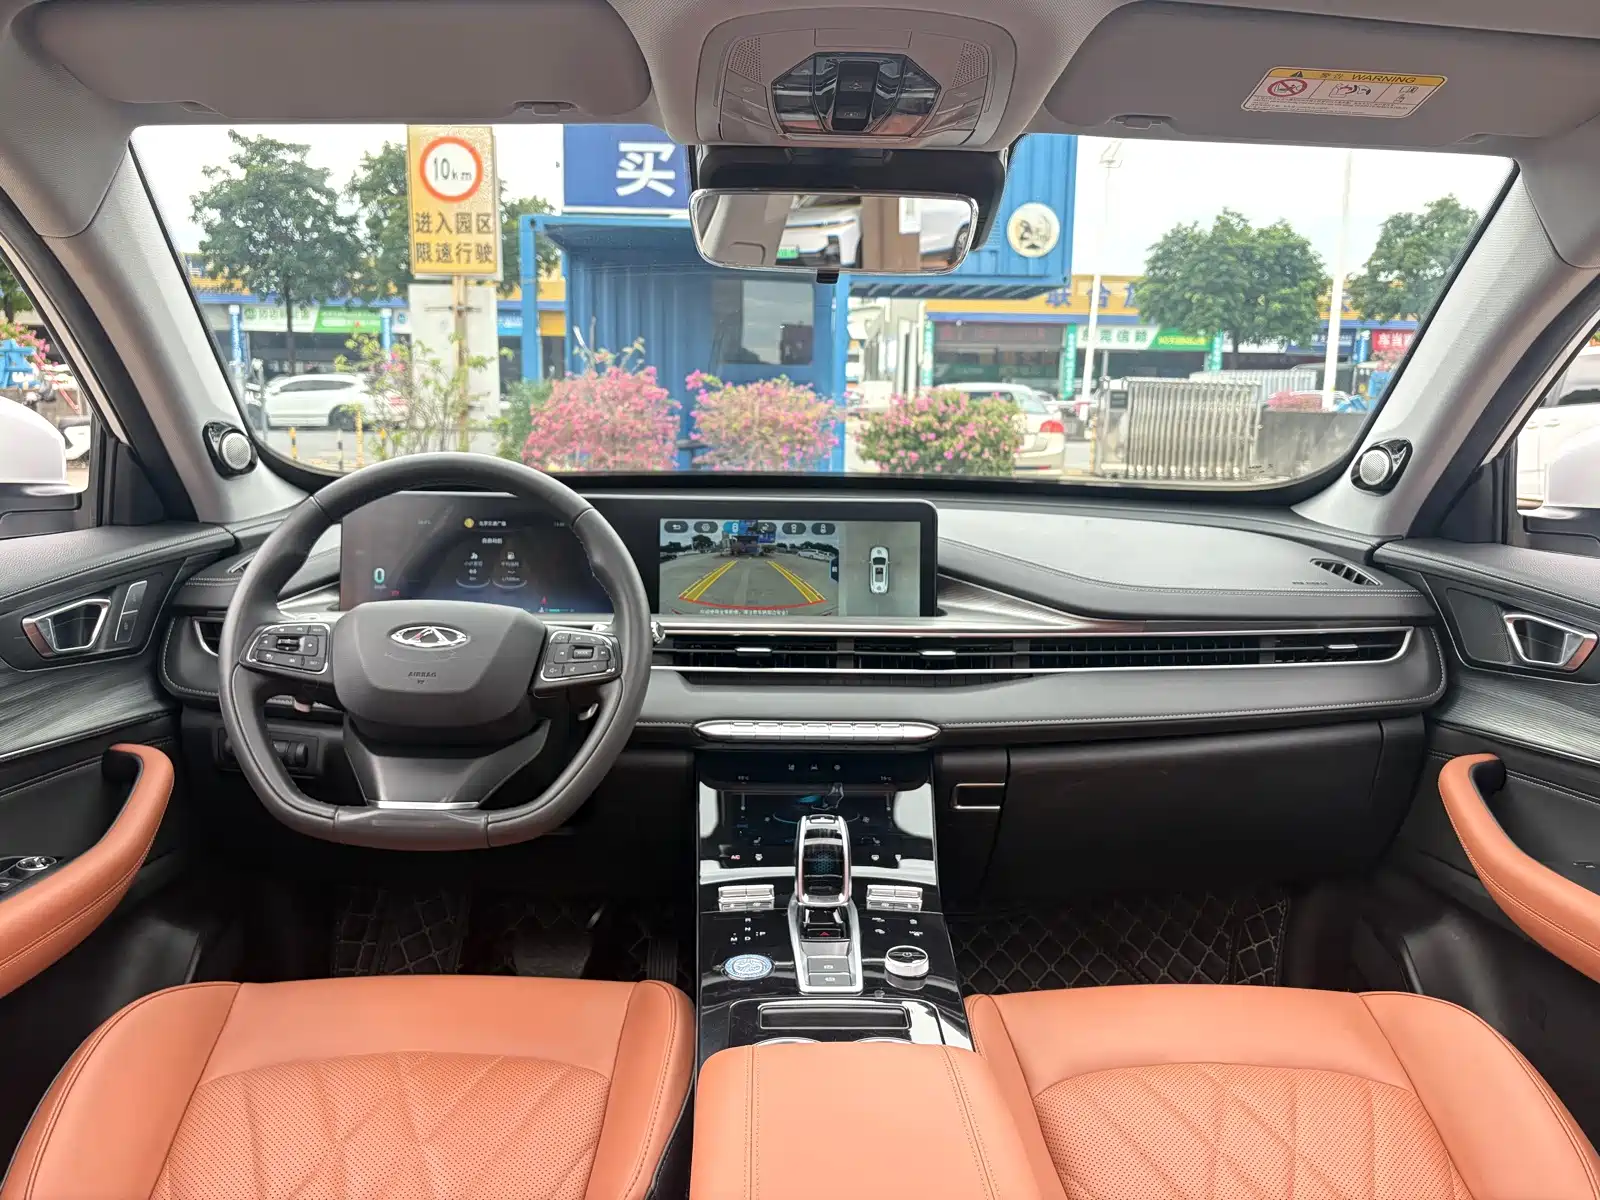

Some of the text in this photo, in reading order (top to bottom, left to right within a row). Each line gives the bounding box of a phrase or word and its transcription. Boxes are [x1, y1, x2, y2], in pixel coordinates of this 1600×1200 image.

[1352, 74, 1417, 84] WARNING
[615, 140, 677, 198] 买
[415, 212, 494, 235] 进入园区
[415, 242, 494, 264] 限速行驶
[374, 567, 385, 584] 0
